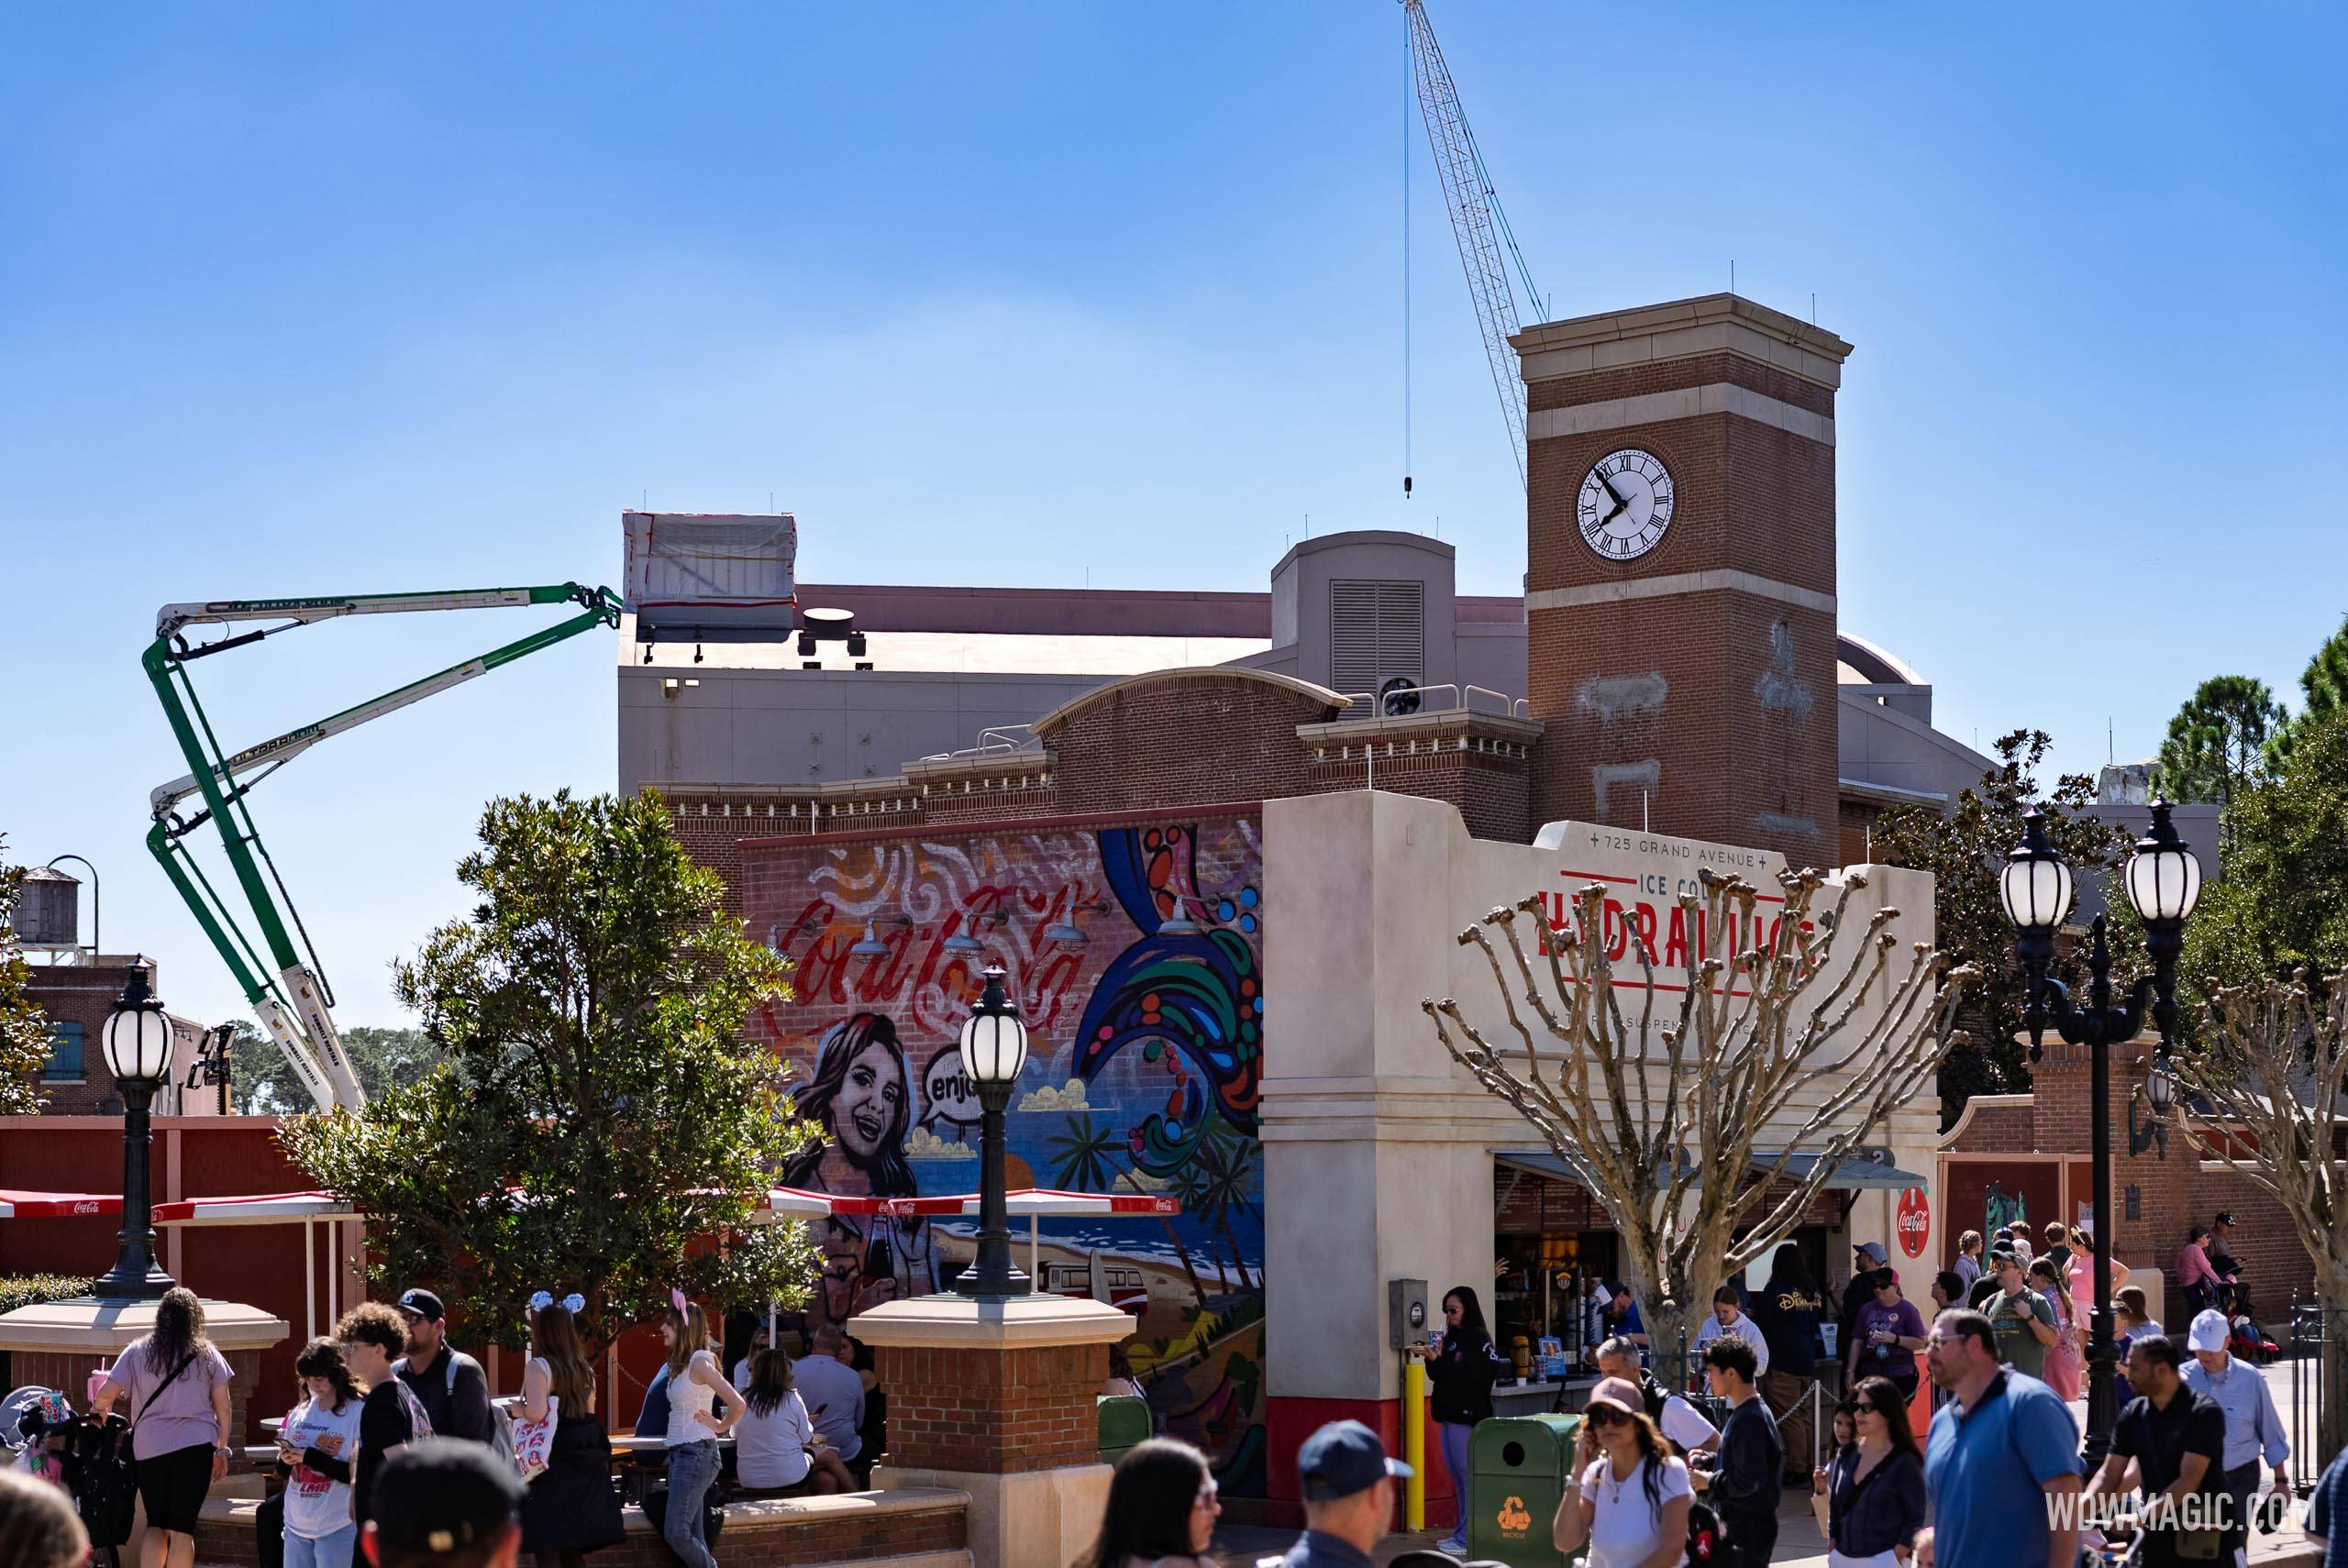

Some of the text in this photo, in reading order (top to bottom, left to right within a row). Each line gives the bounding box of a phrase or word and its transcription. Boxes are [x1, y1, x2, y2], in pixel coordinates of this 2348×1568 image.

[1619, 454, 1632, 471] XII
[1587, 482, 1601, 494] X
[1582, 503, 1596, 514] IX
[1654, 496, 1669, 505] III
[1639, 532, 1649, 547] V
[1604, 835, 1754, 867] 725 GRAND AVENUE
[1640, 874, 1708, 900] ICE COL
[313, 1013, 327, 1040] SUNBELT
[324, 1040, 339, 1067] RENTALS
[285, 1040, 319, 1087] SUNBELT RENTALS
[932, 1069, 978, 1104] enjo
